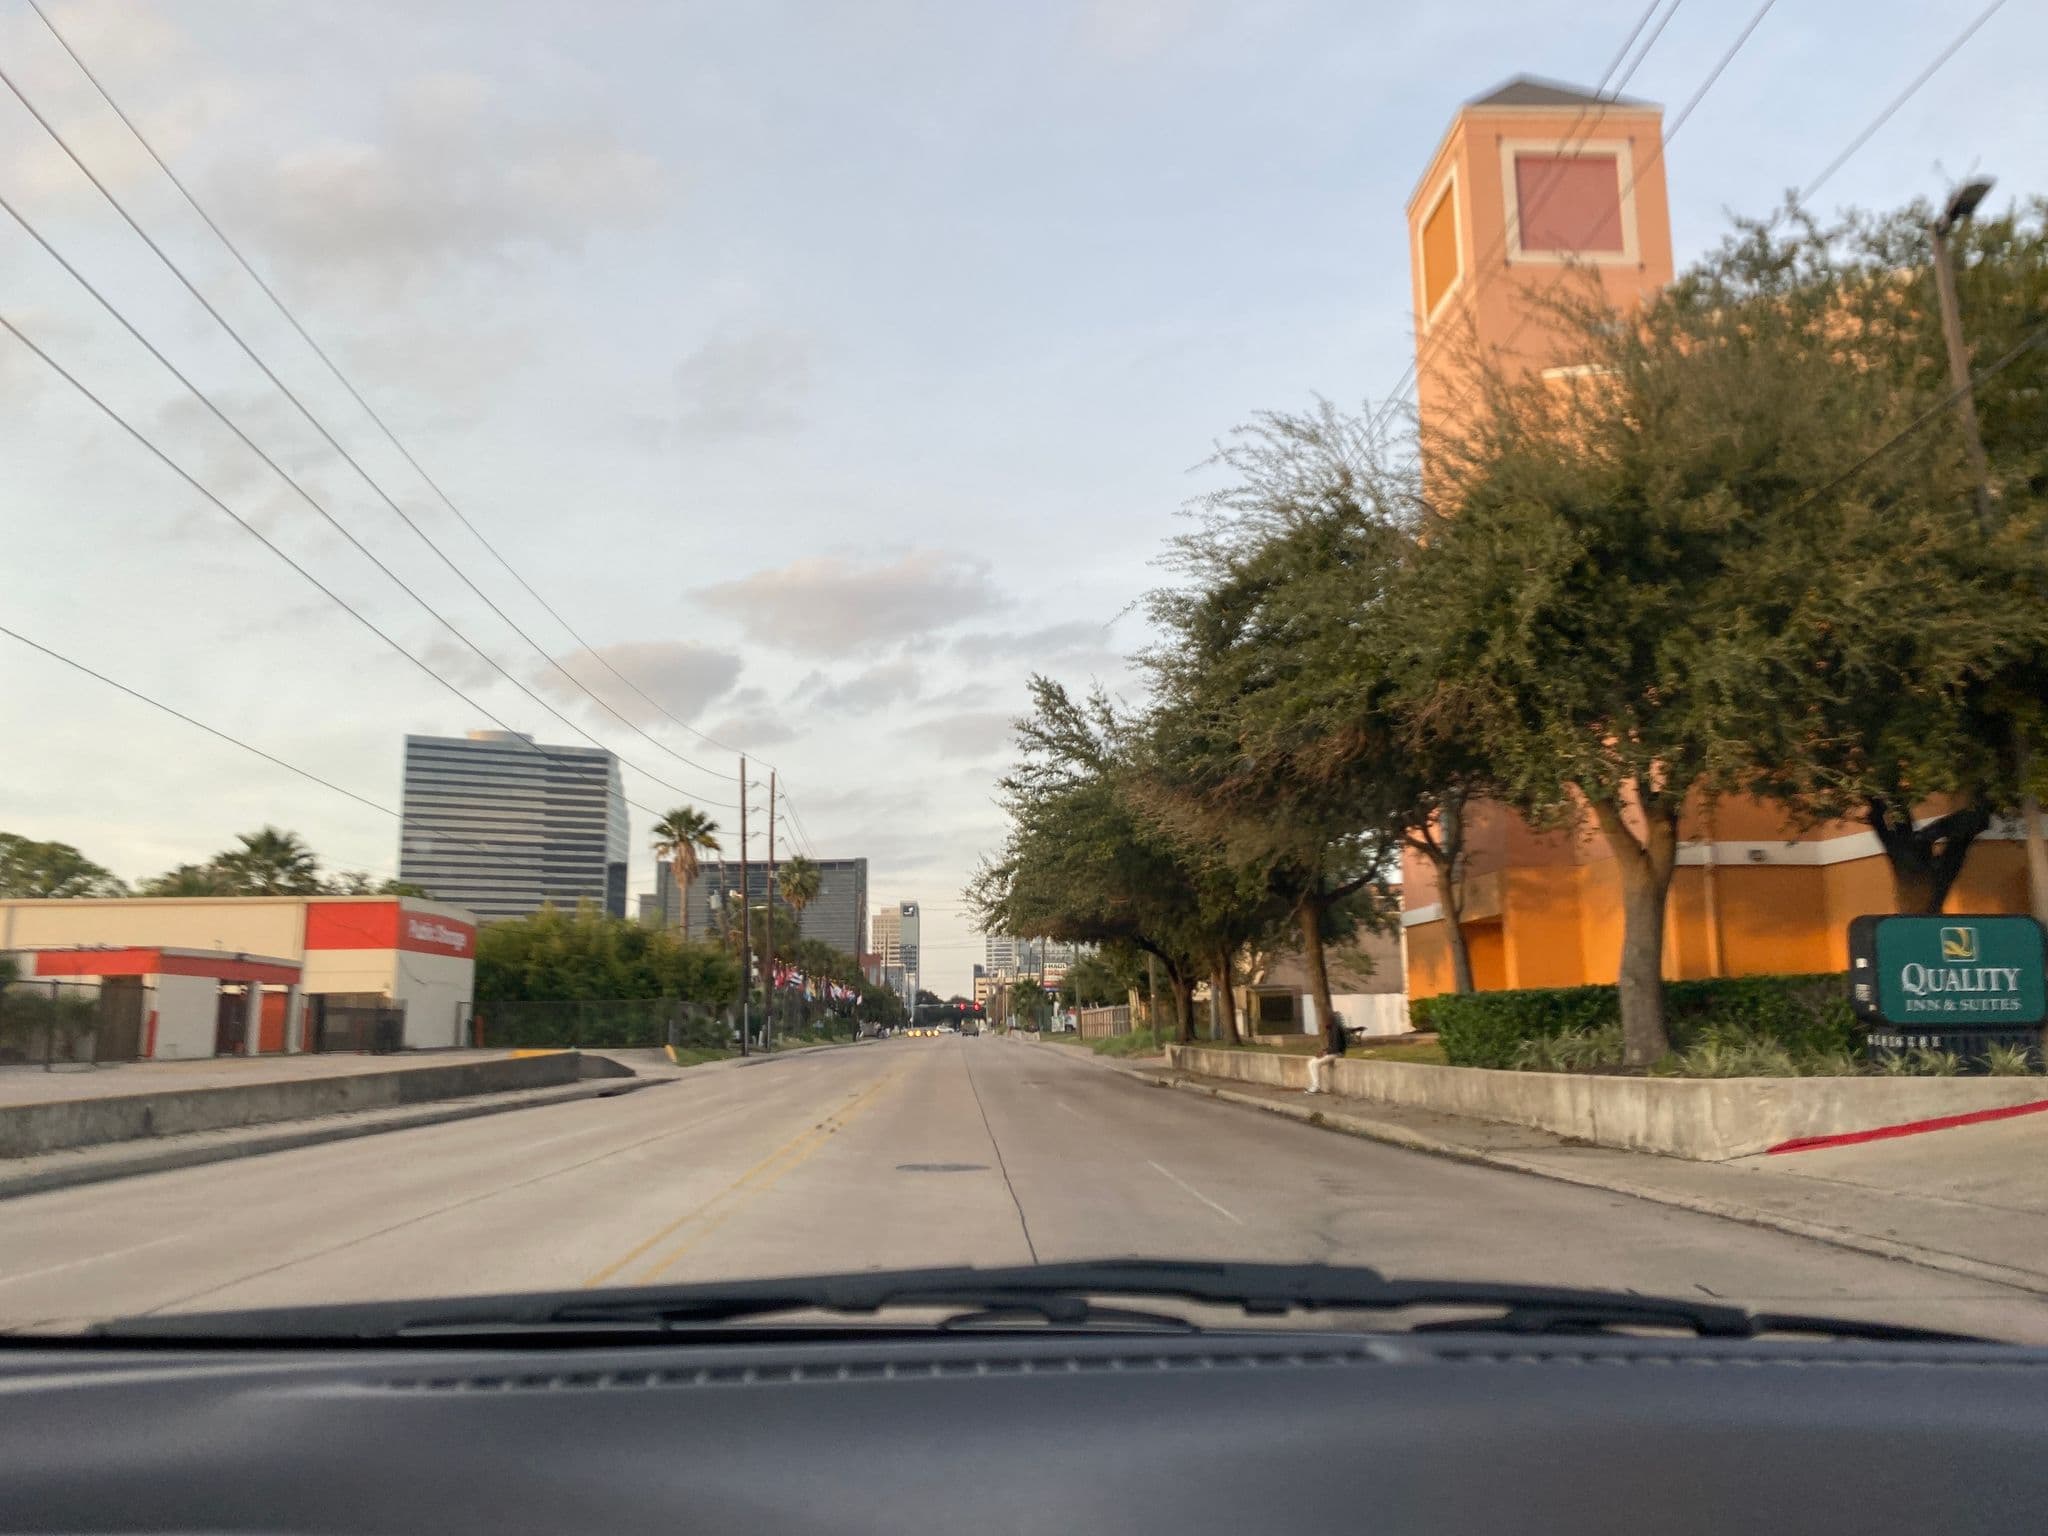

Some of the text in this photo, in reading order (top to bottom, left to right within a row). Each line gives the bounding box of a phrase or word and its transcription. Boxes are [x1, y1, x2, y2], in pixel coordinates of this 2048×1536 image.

[1902, 962, 2022, 996] QUALITY
[1906, 998, 2022, 1012] INN & SUITES
